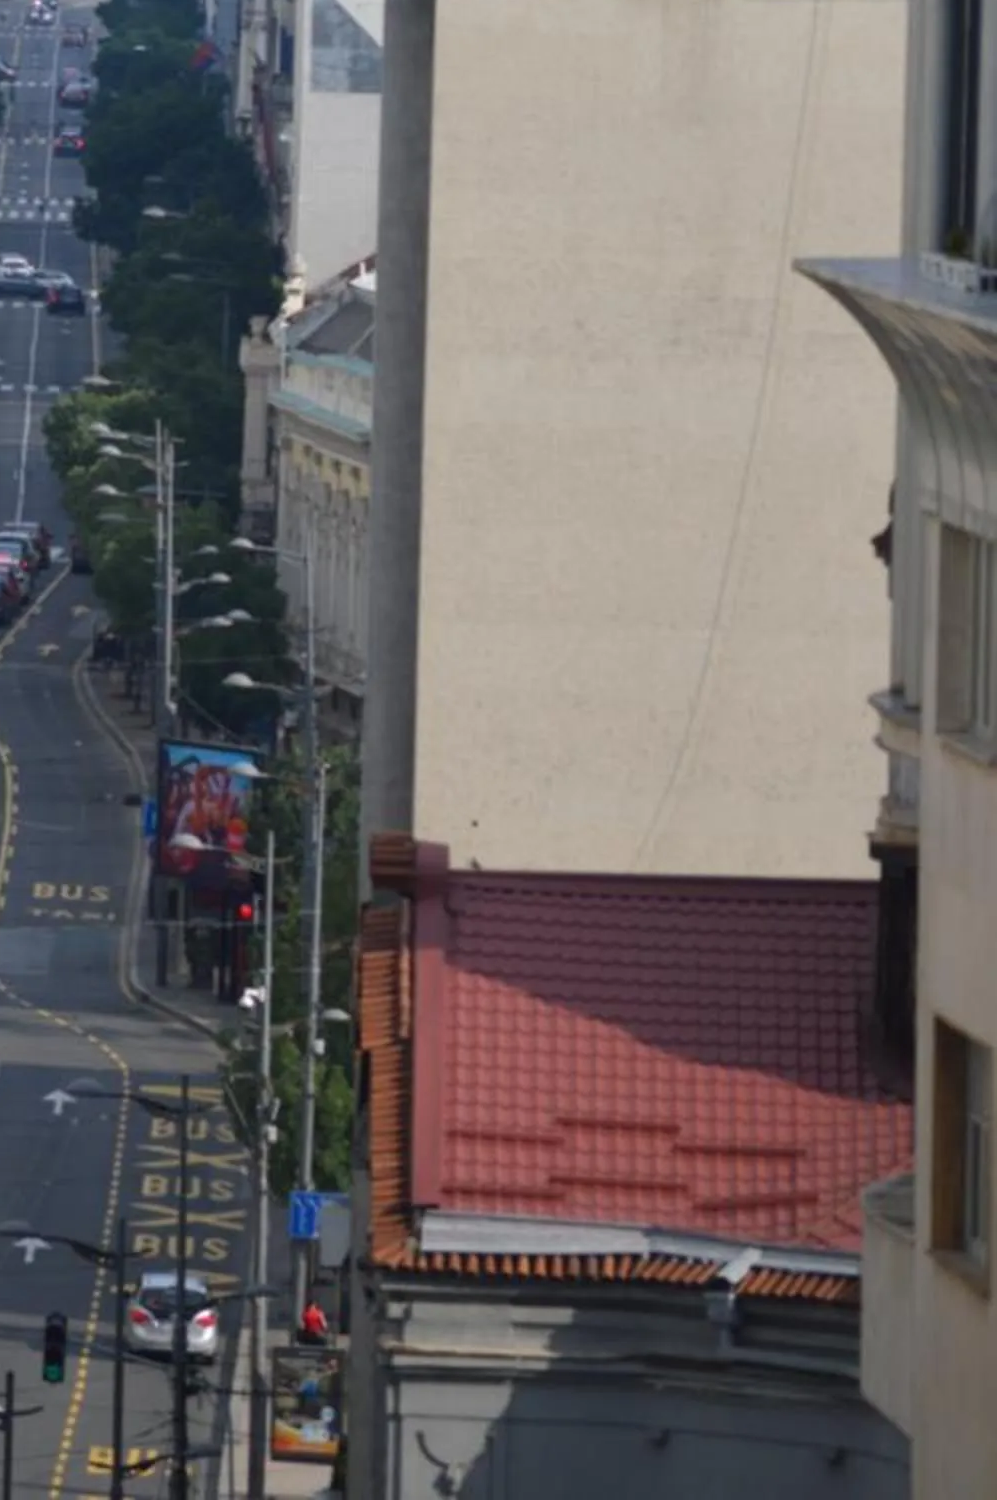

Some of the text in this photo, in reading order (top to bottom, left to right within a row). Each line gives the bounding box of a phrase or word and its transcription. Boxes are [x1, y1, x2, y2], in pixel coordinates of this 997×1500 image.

[32, 882, 110, 902] BUS
[151, 1116, 237, 1144] BUS
[141, 1174, 235, 1201] BUS
[133, 1233, 231, 1262] BUS
